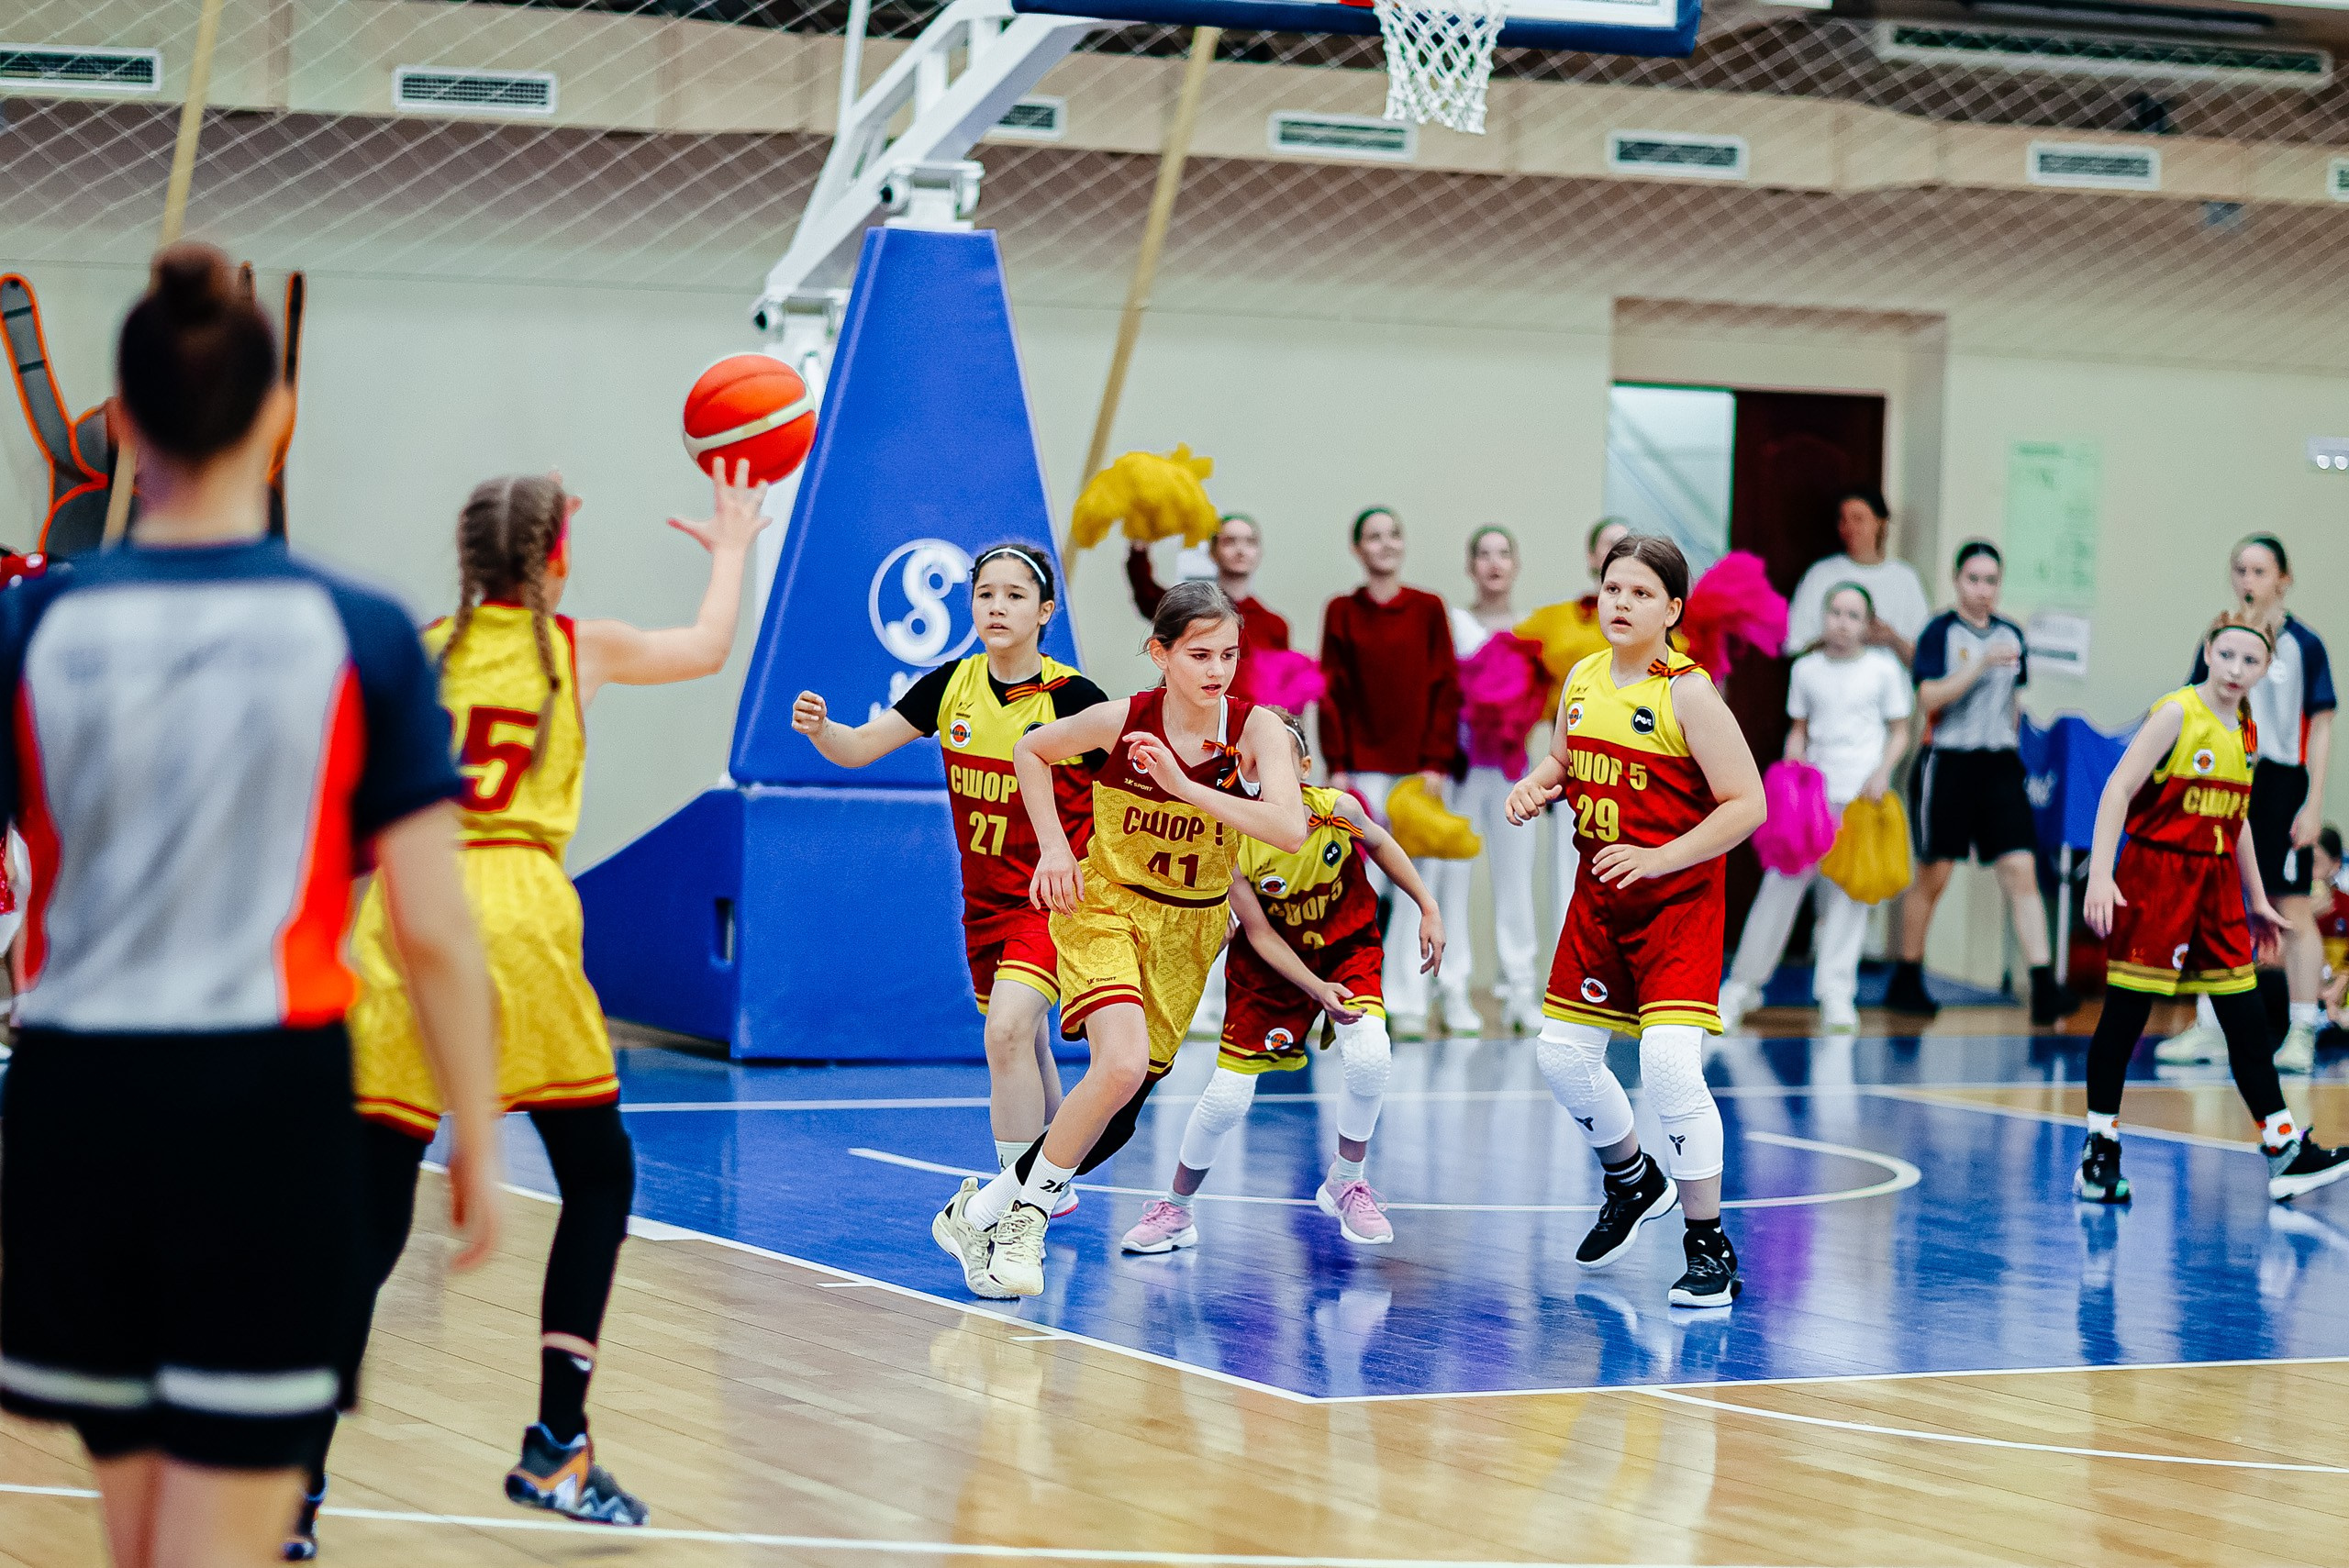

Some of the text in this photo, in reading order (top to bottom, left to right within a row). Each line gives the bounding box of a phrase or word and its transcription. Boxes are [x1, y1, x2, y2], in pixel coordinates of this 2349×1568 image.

[445, 705, 538, 813] 5
[1630, 762, 1648, 791] 5
[950, 764, 1019, 804] СШОР
[1133, 782, 1153, 792] SPORT
[969, 811, 1008, 856] 27
[1122, 806, 1206, 842] СШОР
[1576, 794, 1620, 842] 29
[2212, 824, 2224, 855] 1
[1147, 851, 1199, 888] 41
